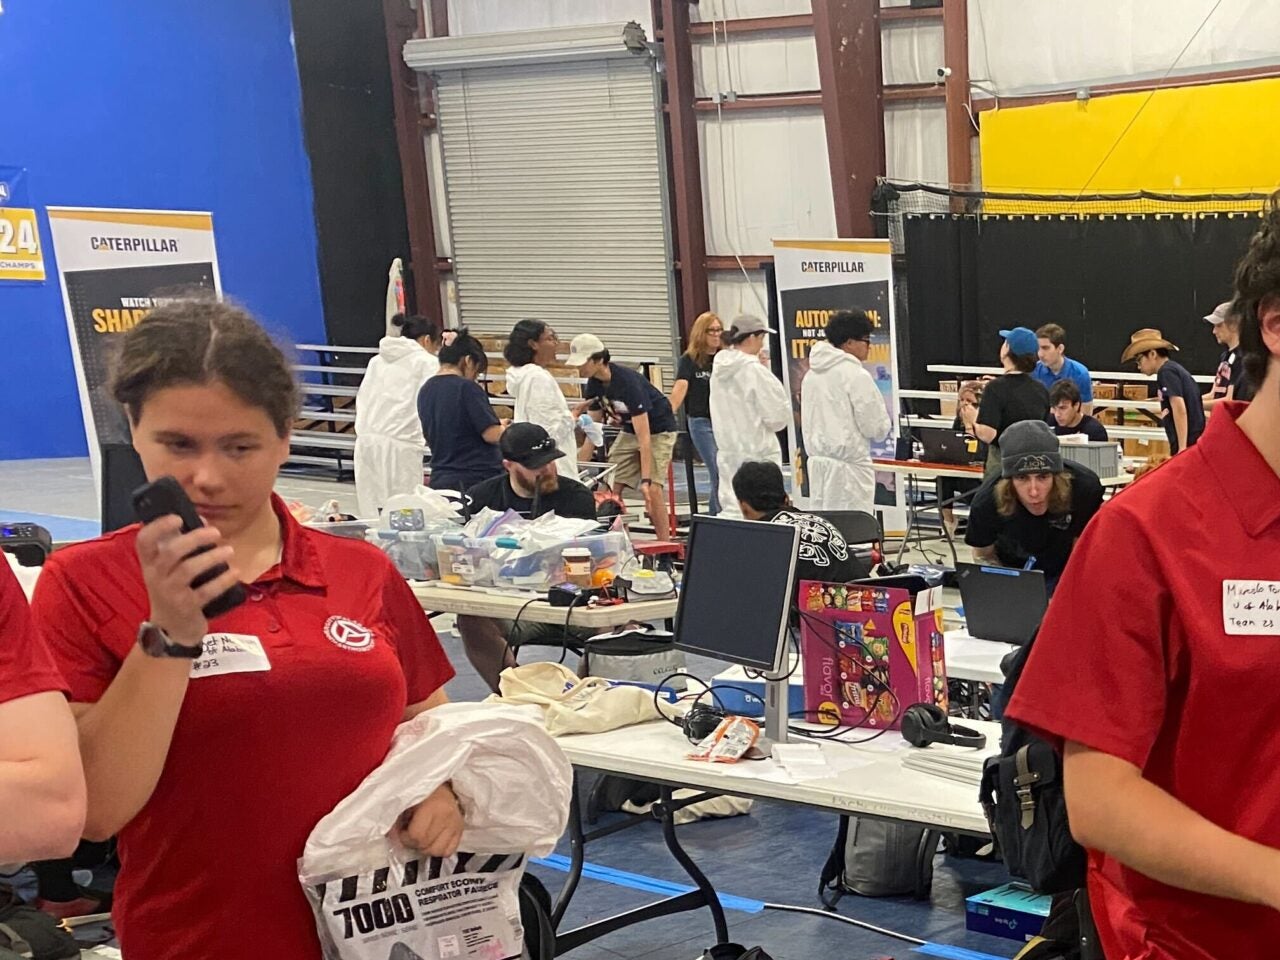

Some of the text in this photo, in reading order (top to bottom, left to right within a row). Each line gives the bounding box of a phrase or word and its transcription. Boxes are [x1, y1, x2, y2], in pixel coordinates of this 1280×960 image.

[90, 236, 178, 252] CATERPILLAR
[801, 261, 864, 273] CATERPILLAR
[120, 297, 151, 308] WATCH
[192, 658, 219, 671] #23
[415, 882, 449, 897] COMFORT
[333, 892, 415, 939] 7000
